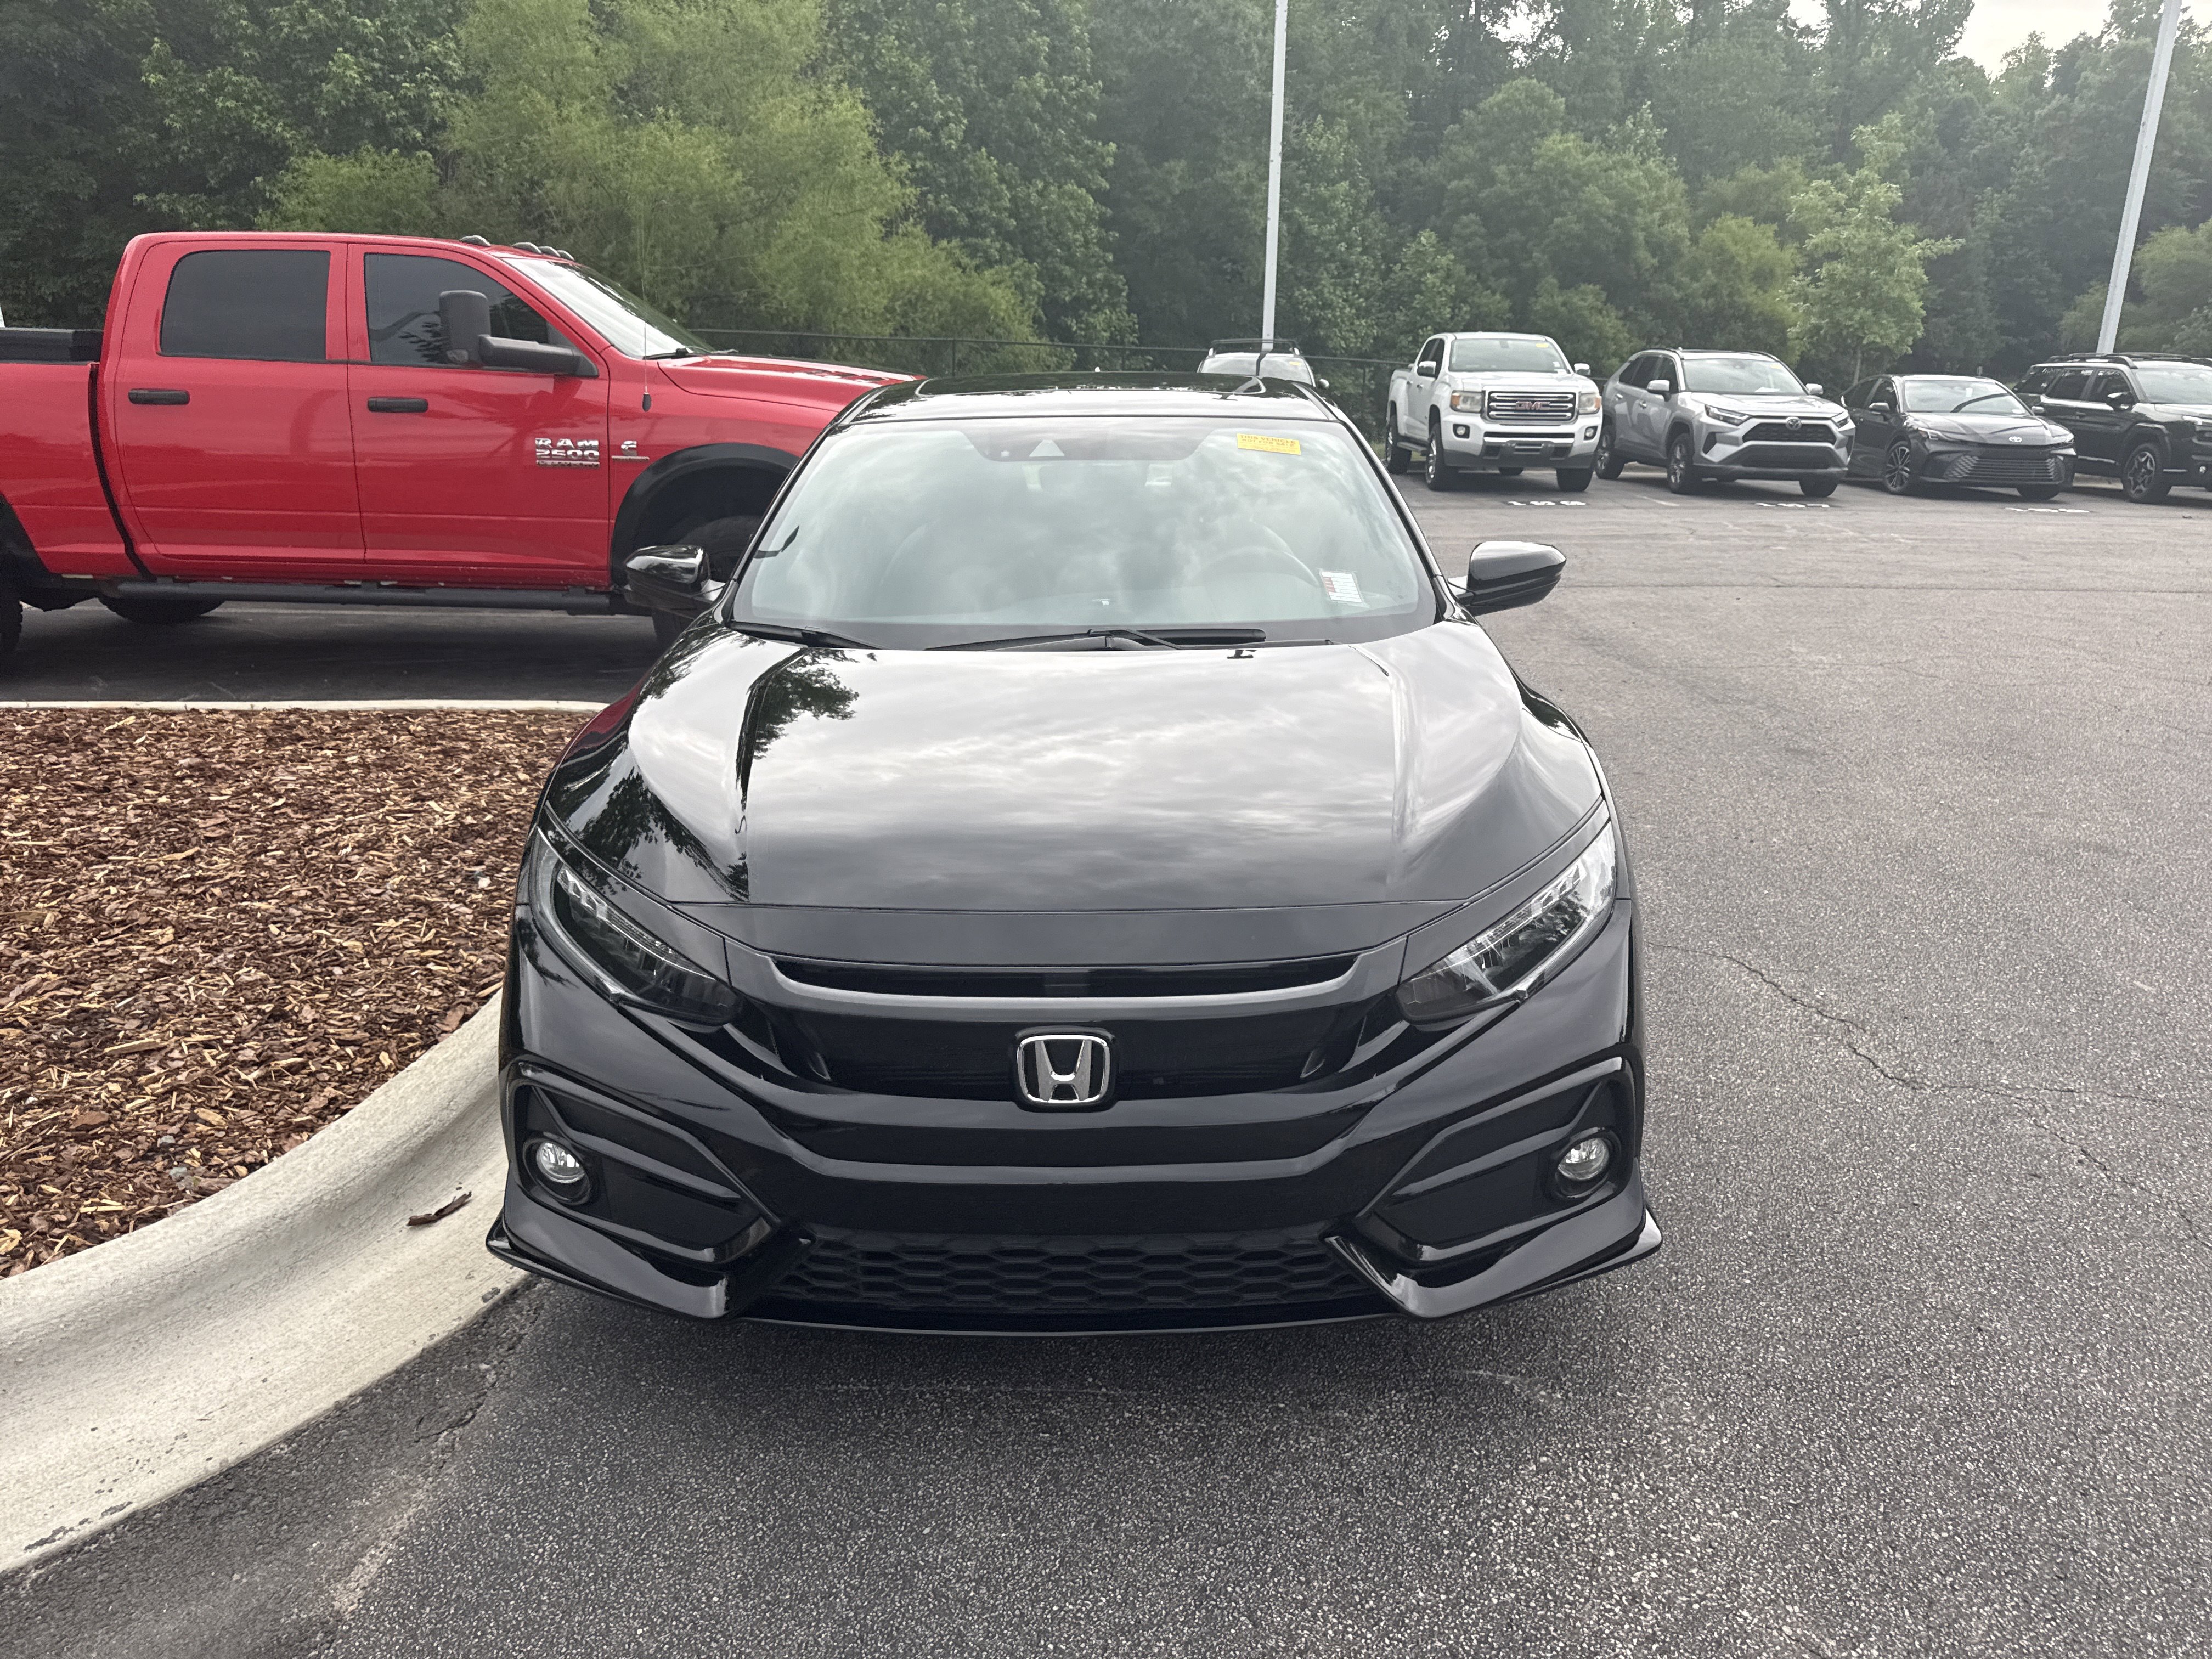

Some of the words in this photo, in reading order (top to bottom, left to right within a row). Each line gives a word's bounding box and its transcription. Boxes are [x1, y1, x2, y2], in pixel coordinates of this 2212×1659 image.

[1515, 401, 1551, 410] GMC
[535, 437, 599, 450] RAM
[535, 449, 600, 460] 2500
